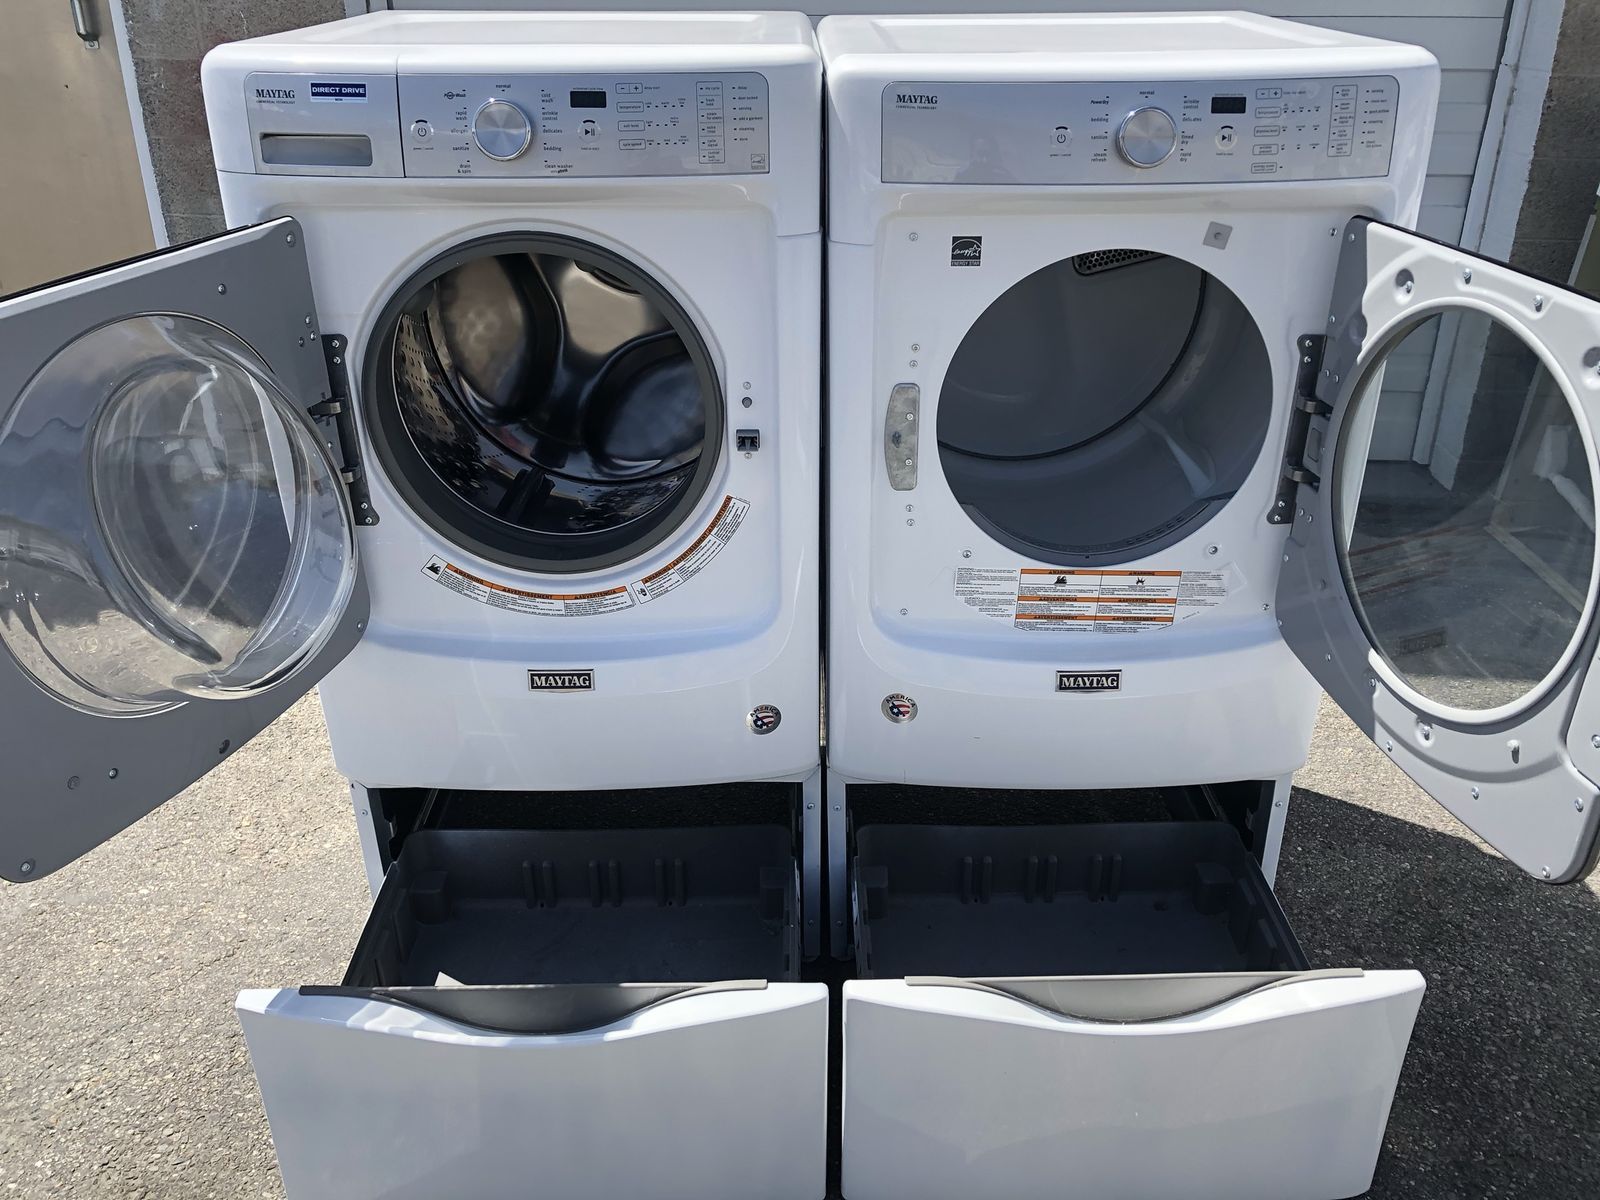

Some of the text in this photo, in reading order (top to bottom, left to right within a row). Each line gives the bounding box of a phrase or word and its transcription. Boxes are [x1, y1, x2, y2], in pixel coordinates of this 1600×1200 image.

[256, 89, 295, 98] MAYTAG
[896, 94, 938, 104] MAYTAG
[532, 675, 590, 687] MAYTAG
[1060, 676, 1118, 688] MAYTAG
[886, 694, 916, 708] AMERICA
